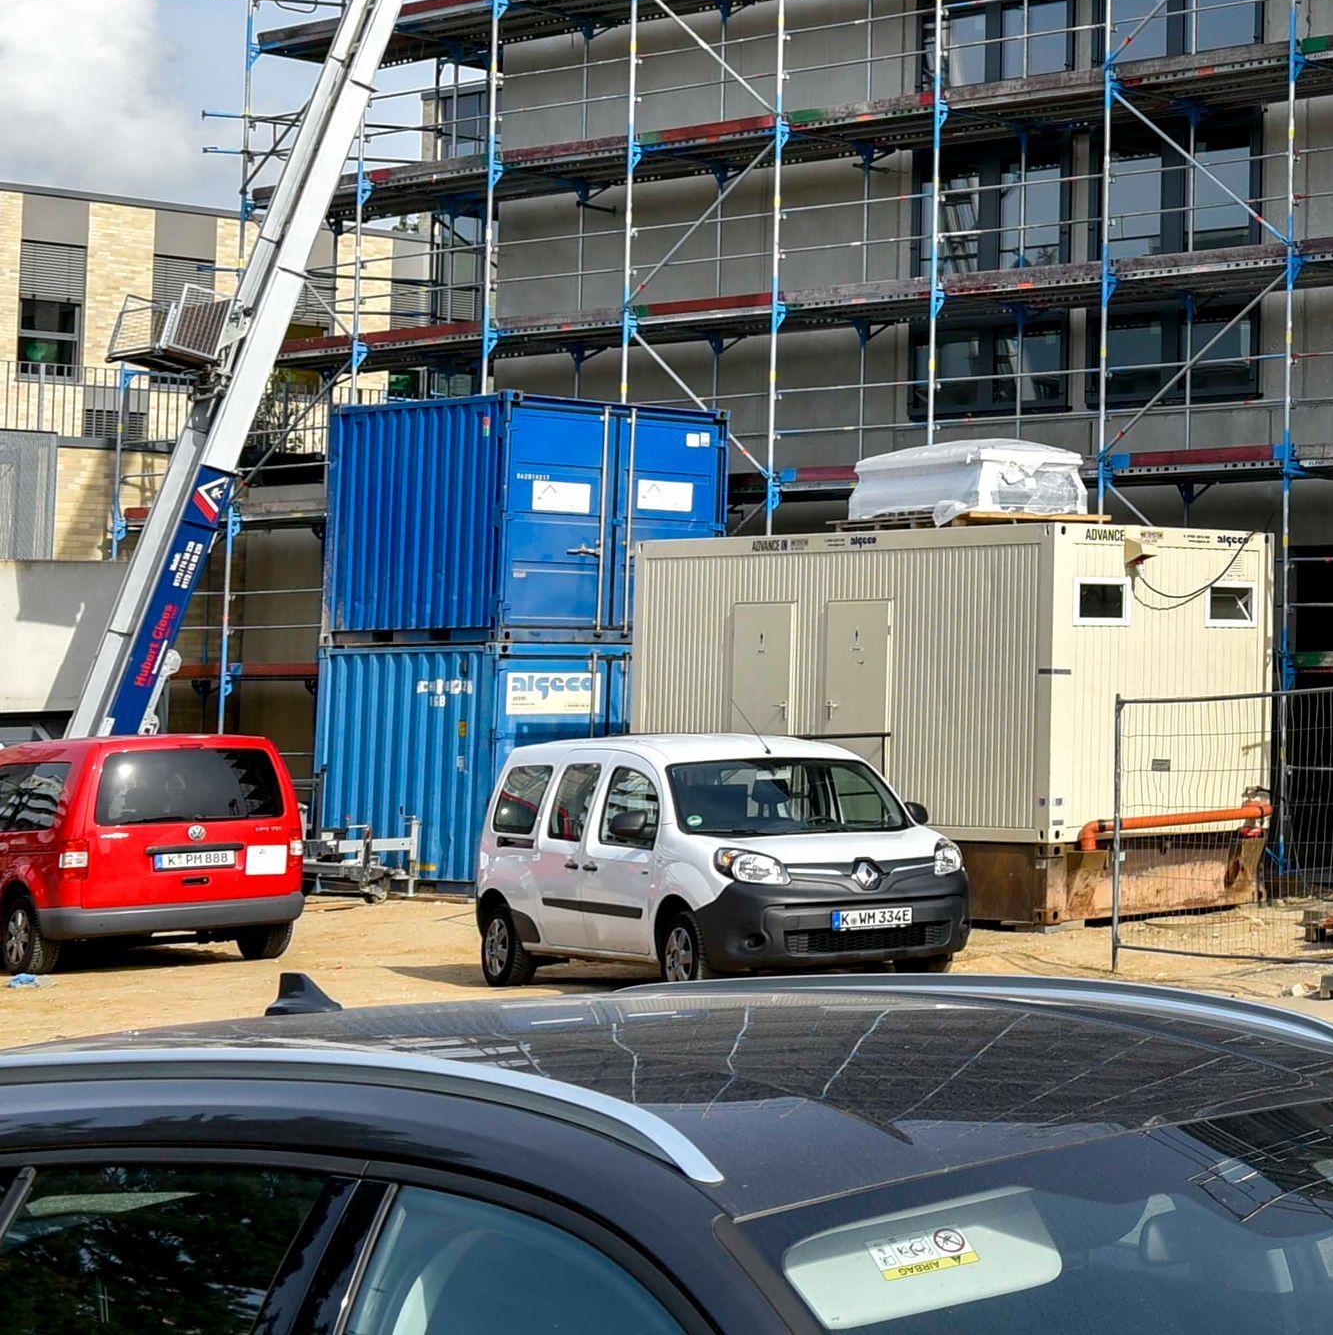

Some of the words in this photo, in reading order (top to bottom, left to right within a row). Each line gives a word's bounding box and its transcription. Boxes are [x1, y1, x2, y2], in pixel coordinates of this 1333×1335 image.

[1085, 528, 1125, 542] ADVANCE
[752, 539, 780, 552] ADVANCE
[168, 856, 176, 866] K
[186, 854, 203, 865] PM
[205, 852, 229, 864] 888
[842, 912, 850, 926] K
[859, 911, 876, 925] WM
[879, 909, 911, 924] 334E
[898, 1260, 940, 1276] AIRBAG
